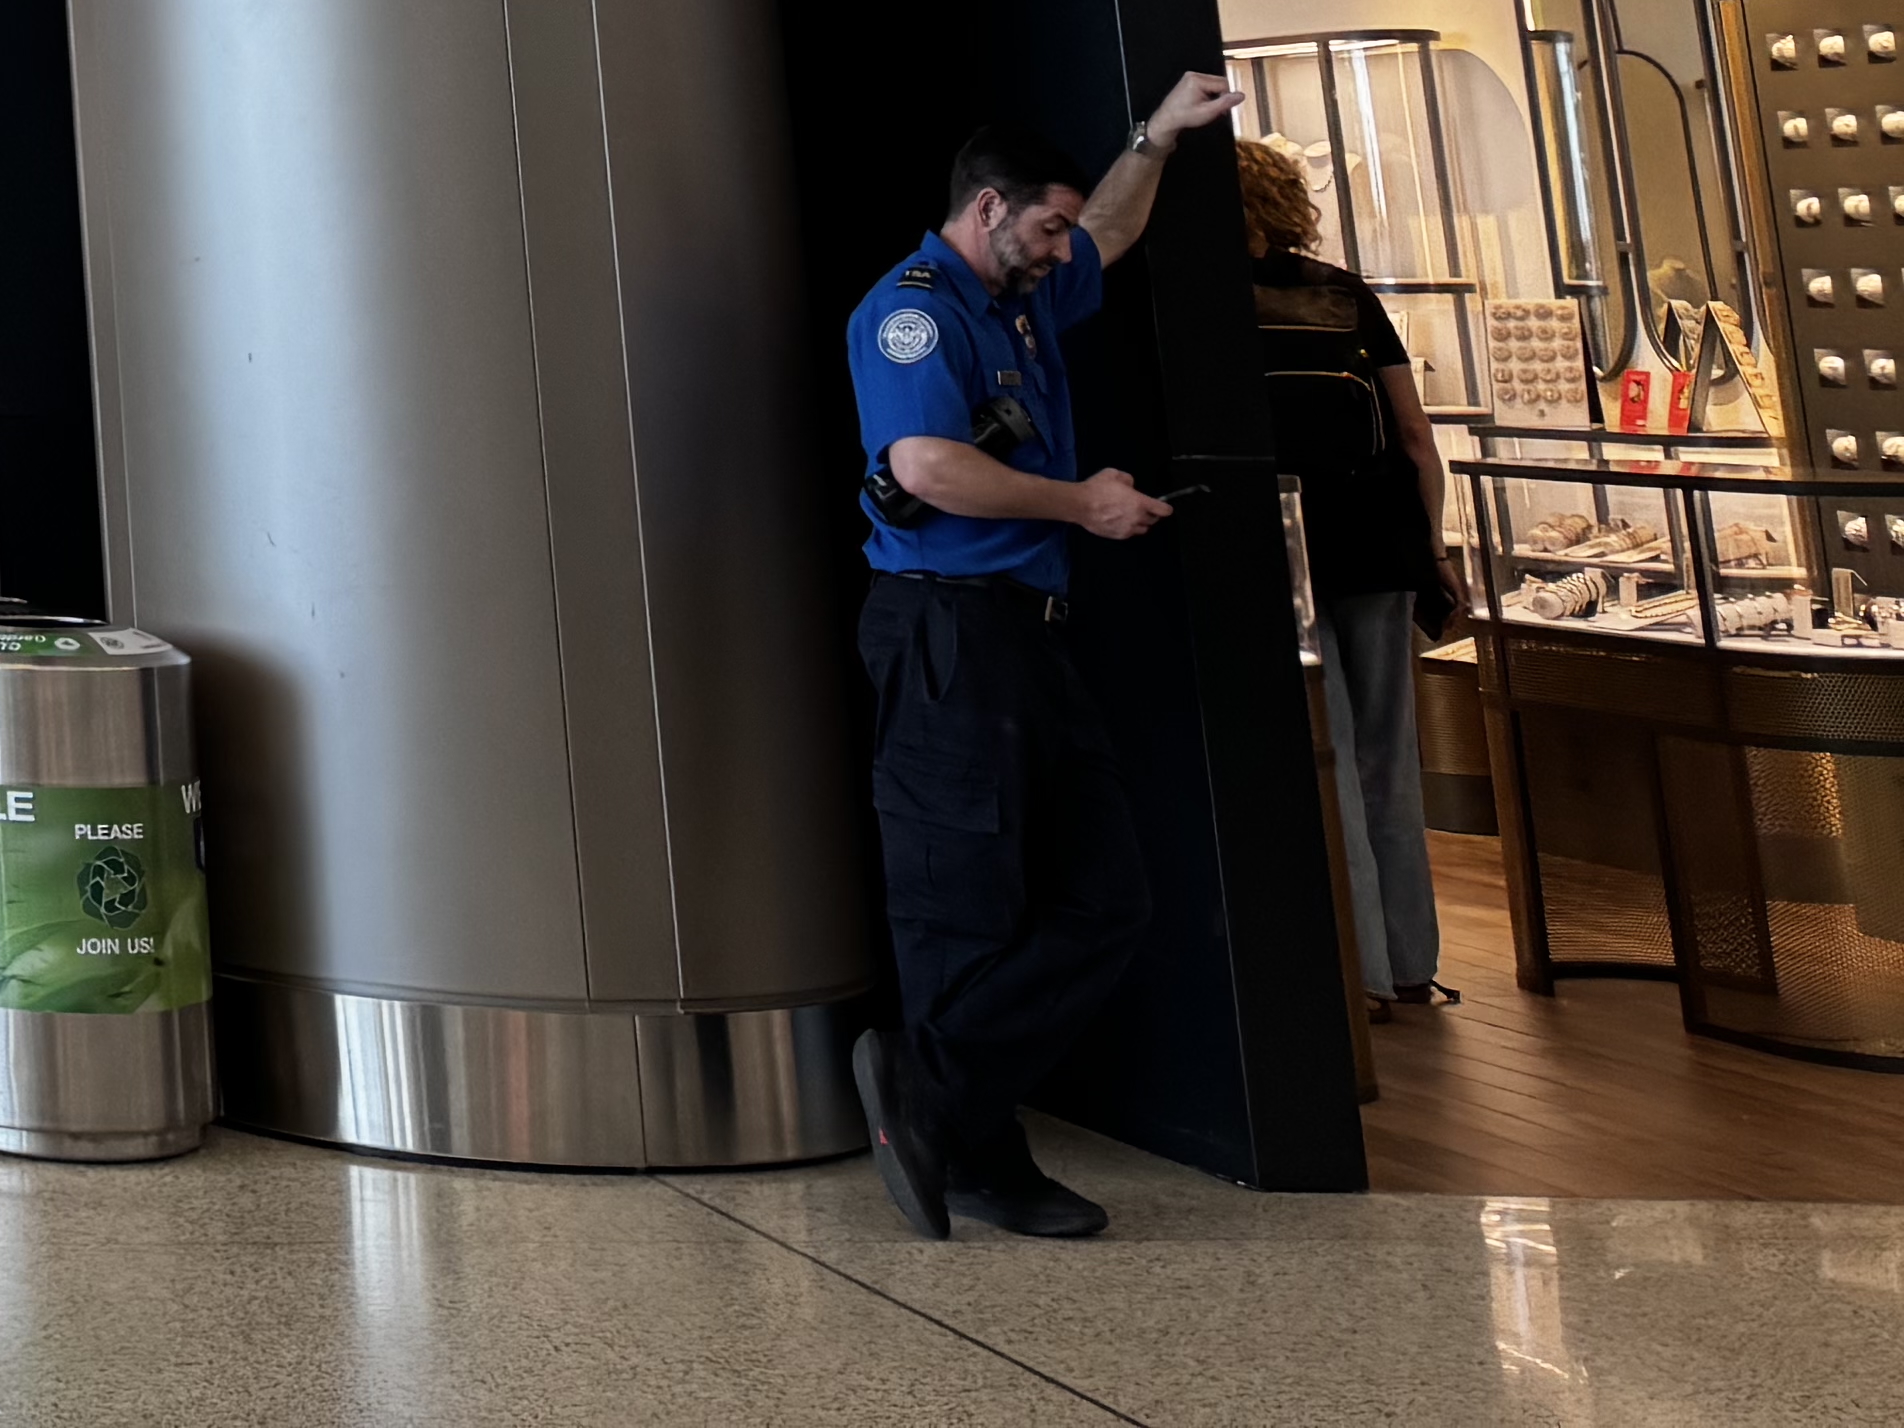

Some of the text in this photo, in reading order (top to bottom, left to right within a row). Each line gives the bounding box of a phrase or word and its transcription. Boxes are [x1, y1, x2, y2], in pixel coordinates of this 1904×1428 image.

[74, 823, 144, 841] PLEASE
[76, 936, 155, 955] JOIN US!
